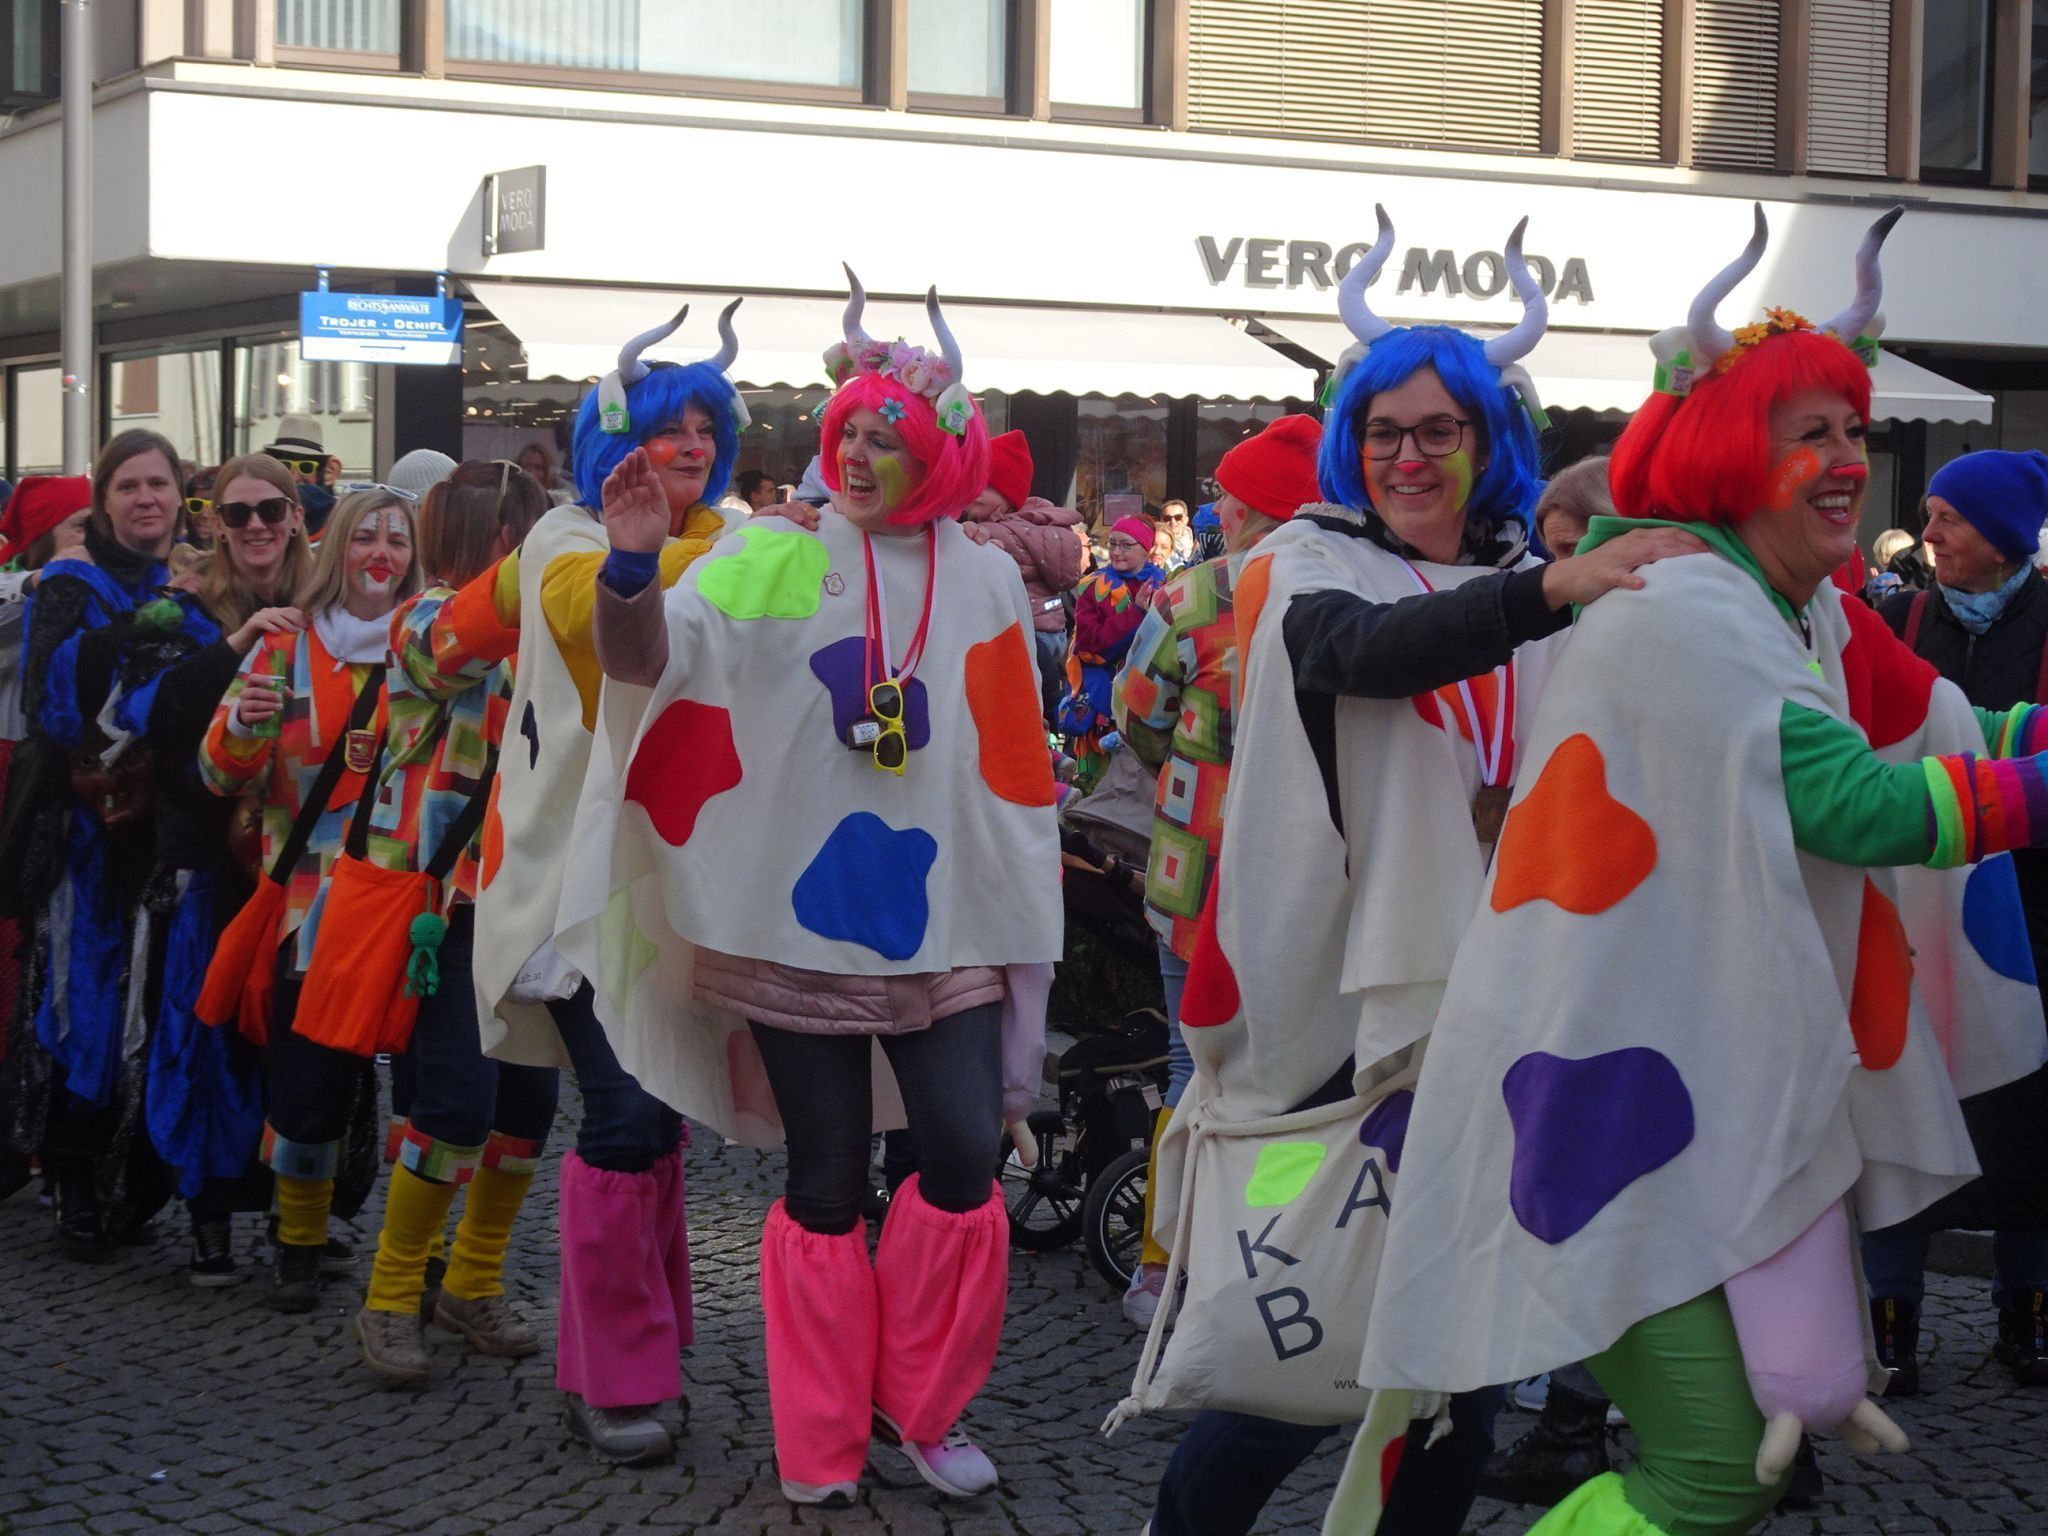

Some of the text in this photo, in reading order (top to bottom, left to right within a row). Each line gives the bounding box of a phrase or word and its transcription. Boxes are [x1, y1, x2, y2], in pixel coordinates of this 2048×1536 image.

[500, 210, 534, 233] MODA
[501, 187, 532, 211] VERO
[1396, 247, 1595, 305] MODA
[319, 315, 377, 328] TROJER
[1334, 1157, 1392, 1229] A
[1236, 1212, 1302, 1280] K
[1255, 1285, 1324, 1361] B
